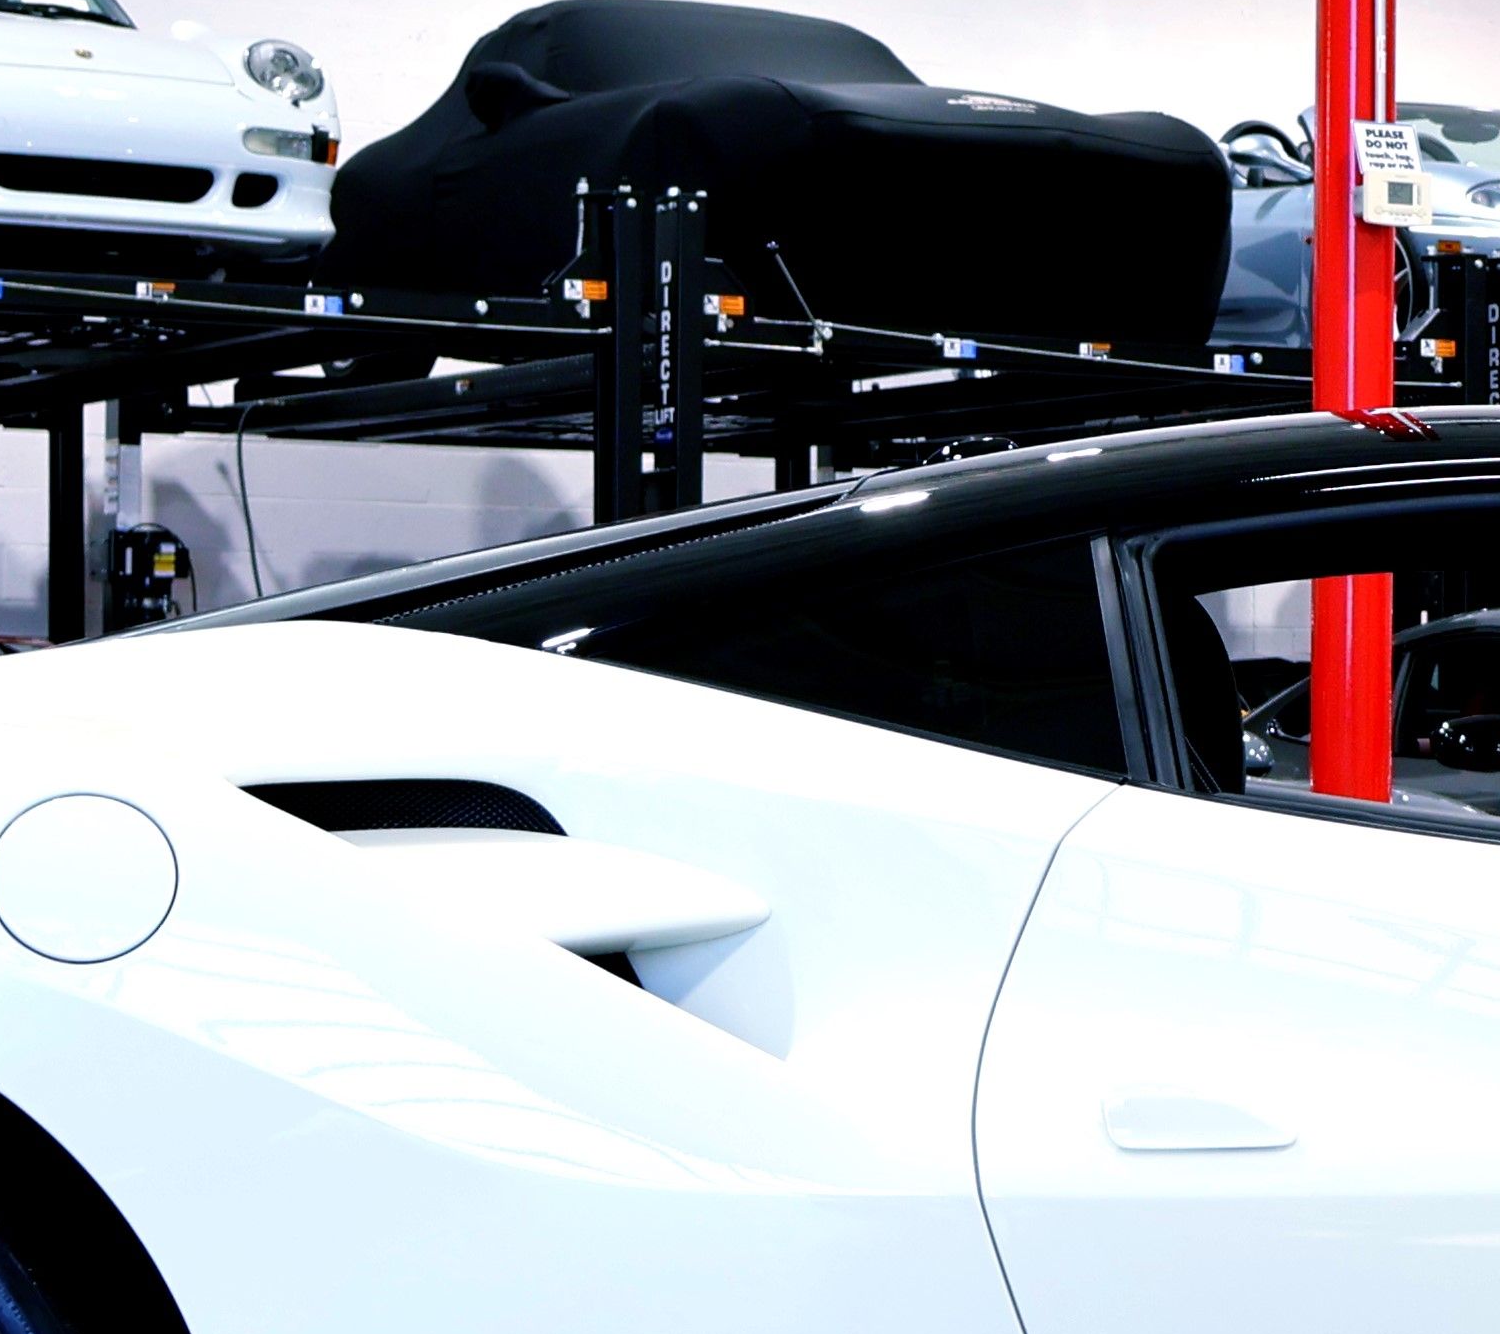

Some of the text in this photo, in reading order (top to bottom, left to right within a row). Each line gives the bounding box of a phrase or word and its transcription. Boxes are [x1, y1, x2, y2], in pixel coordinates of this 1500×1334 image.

[1365, 129, 1404, 139] PLEASE
[1365, 140, 1408, 150] DO NOT
[1365, 151, 1393, 160] touch,
[660, 261, 672, 405] DIRECT
[1488, 303, 1500, 405] DIREC
[655, 407, 675, 426] LIFT
